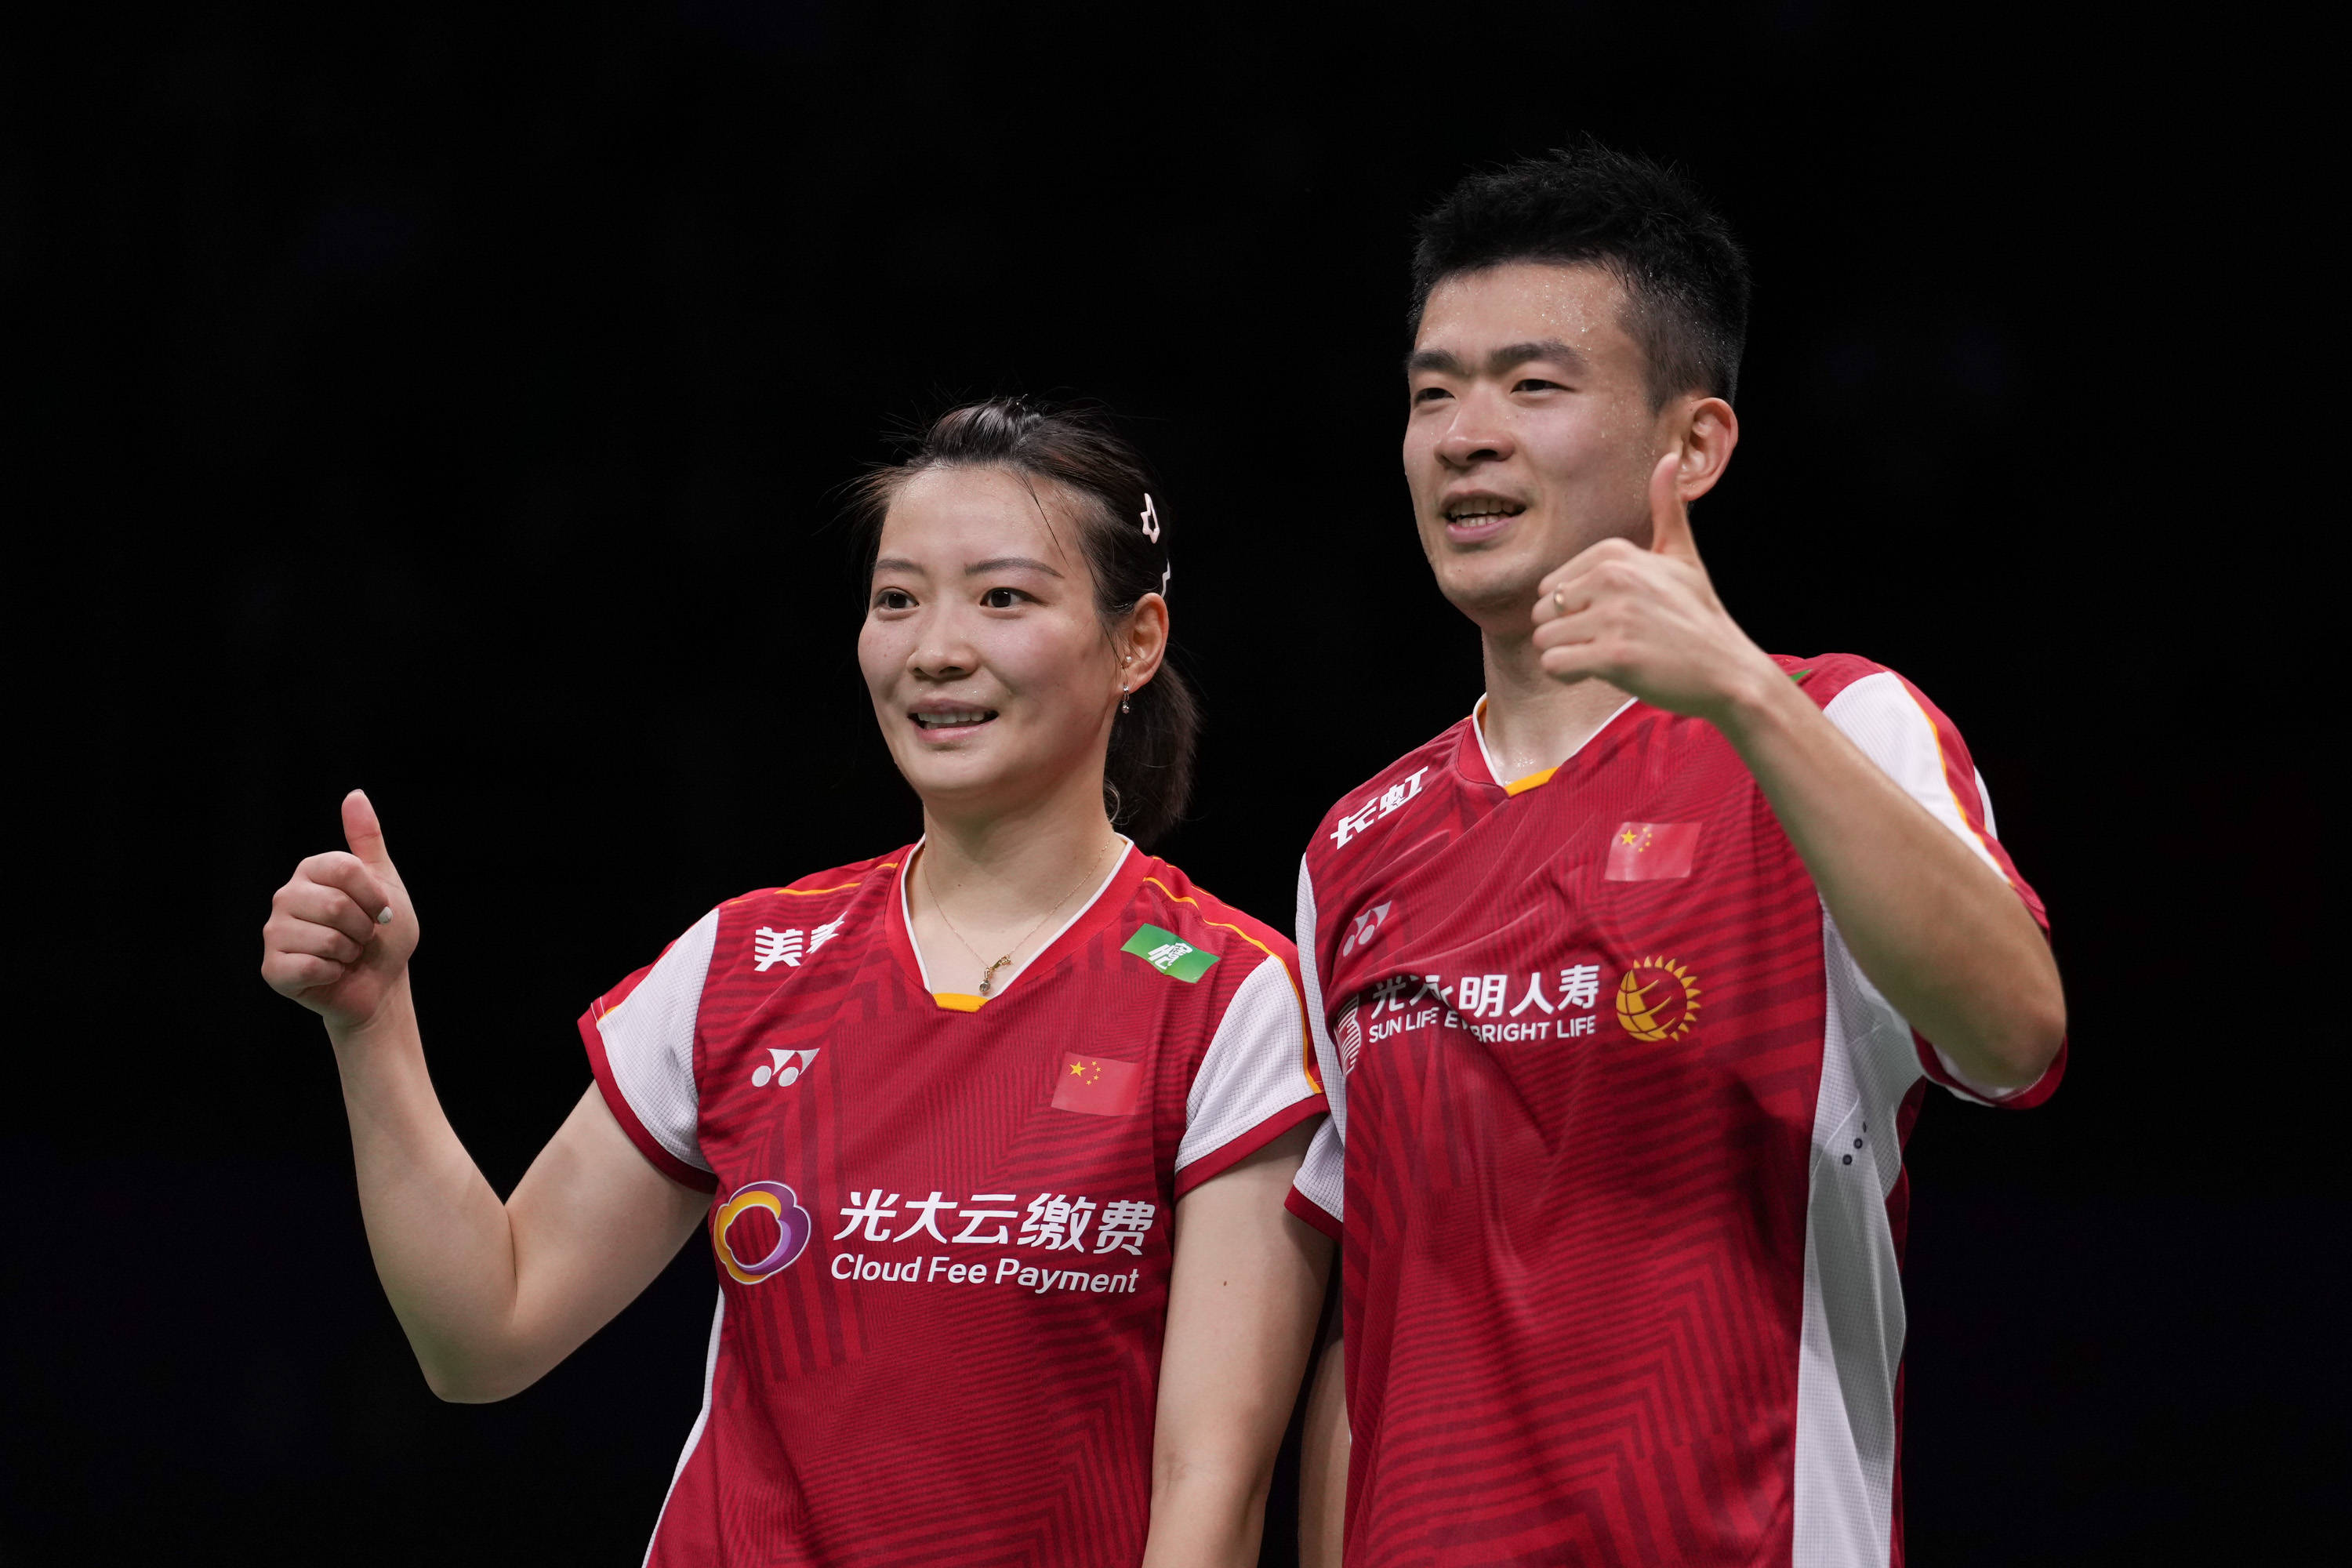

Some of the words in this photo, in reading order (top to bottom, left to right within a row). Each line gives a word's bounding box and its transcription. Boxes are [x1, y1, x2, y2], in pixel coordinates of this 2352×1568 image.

[1330, 765, 1428, 850] 长虹
[1369, 1016, 1402, 1044] SUN
[1405, 1007, 1440, 1031] LIFE
[1444, 1010, 1552, 1043] EBRIGHT
[1557, 1014, 1596, 1039] LIFE
[833, 1189, 1156, 1255] 光大云缴费
[831, 1253, 923, 1282] Cloud
[927, 1256, 987, 1284] Fee
[994, 1258, 1139, 1294] Payment
